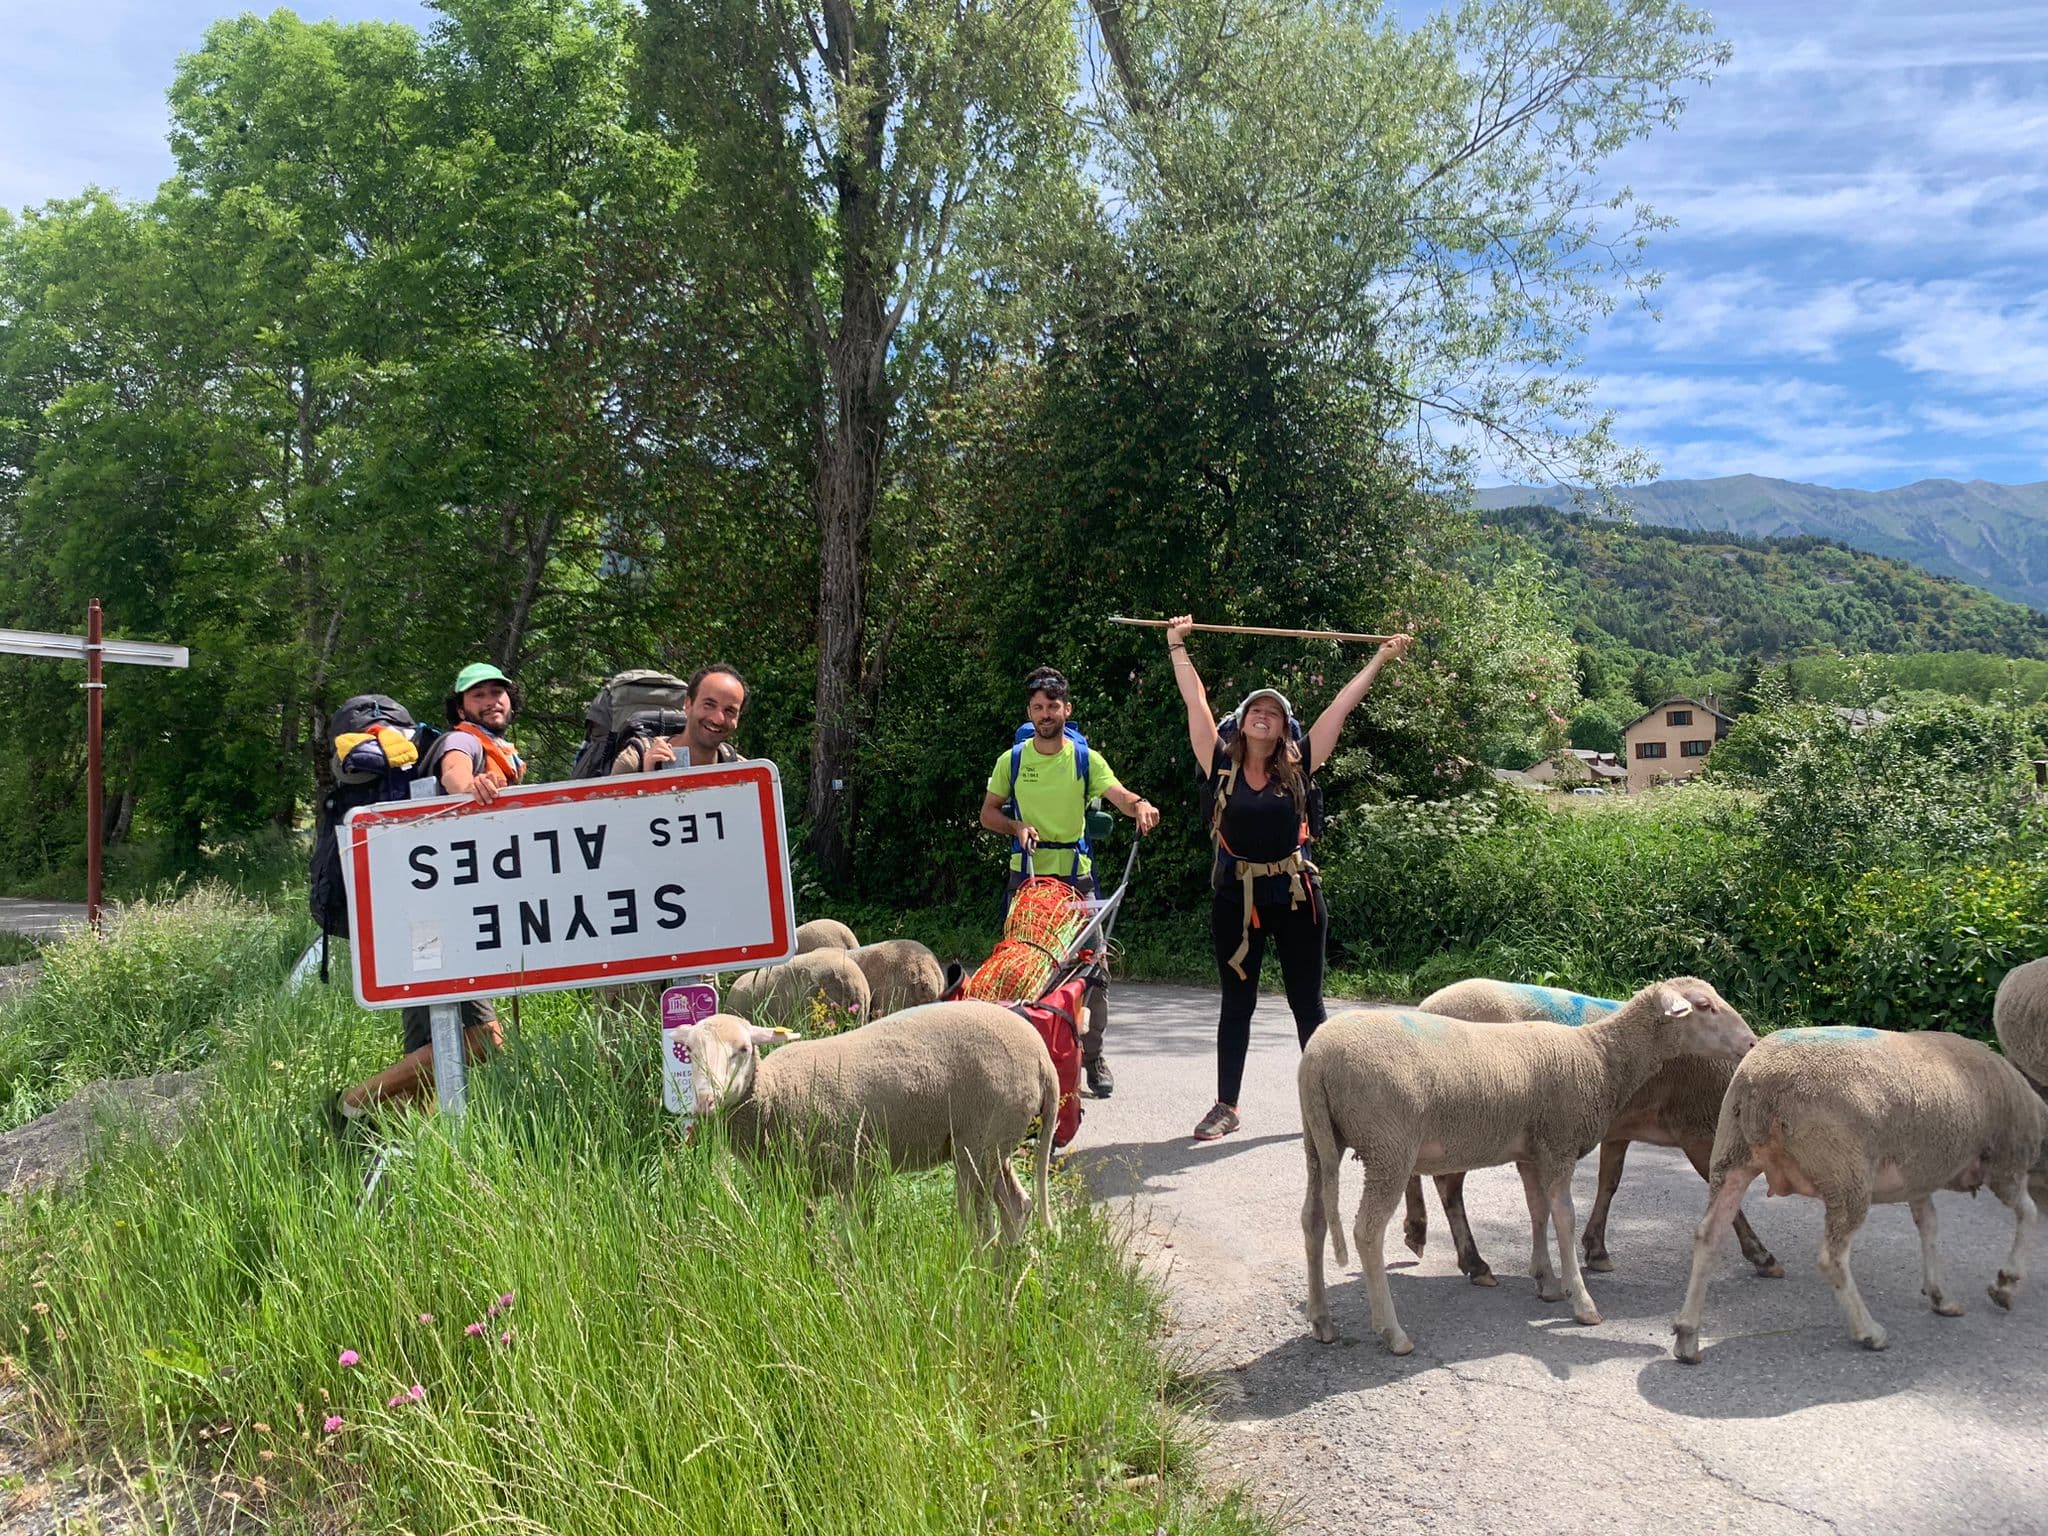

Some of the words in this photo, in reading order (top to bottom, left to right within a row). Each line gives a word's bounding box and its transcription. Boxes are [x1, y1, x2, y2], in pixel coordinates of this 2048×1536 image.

[408, 824, 607, 890] ALPES
[649, 811, 725, 847] LES
[472, 883, 687, 951] SEYNE
